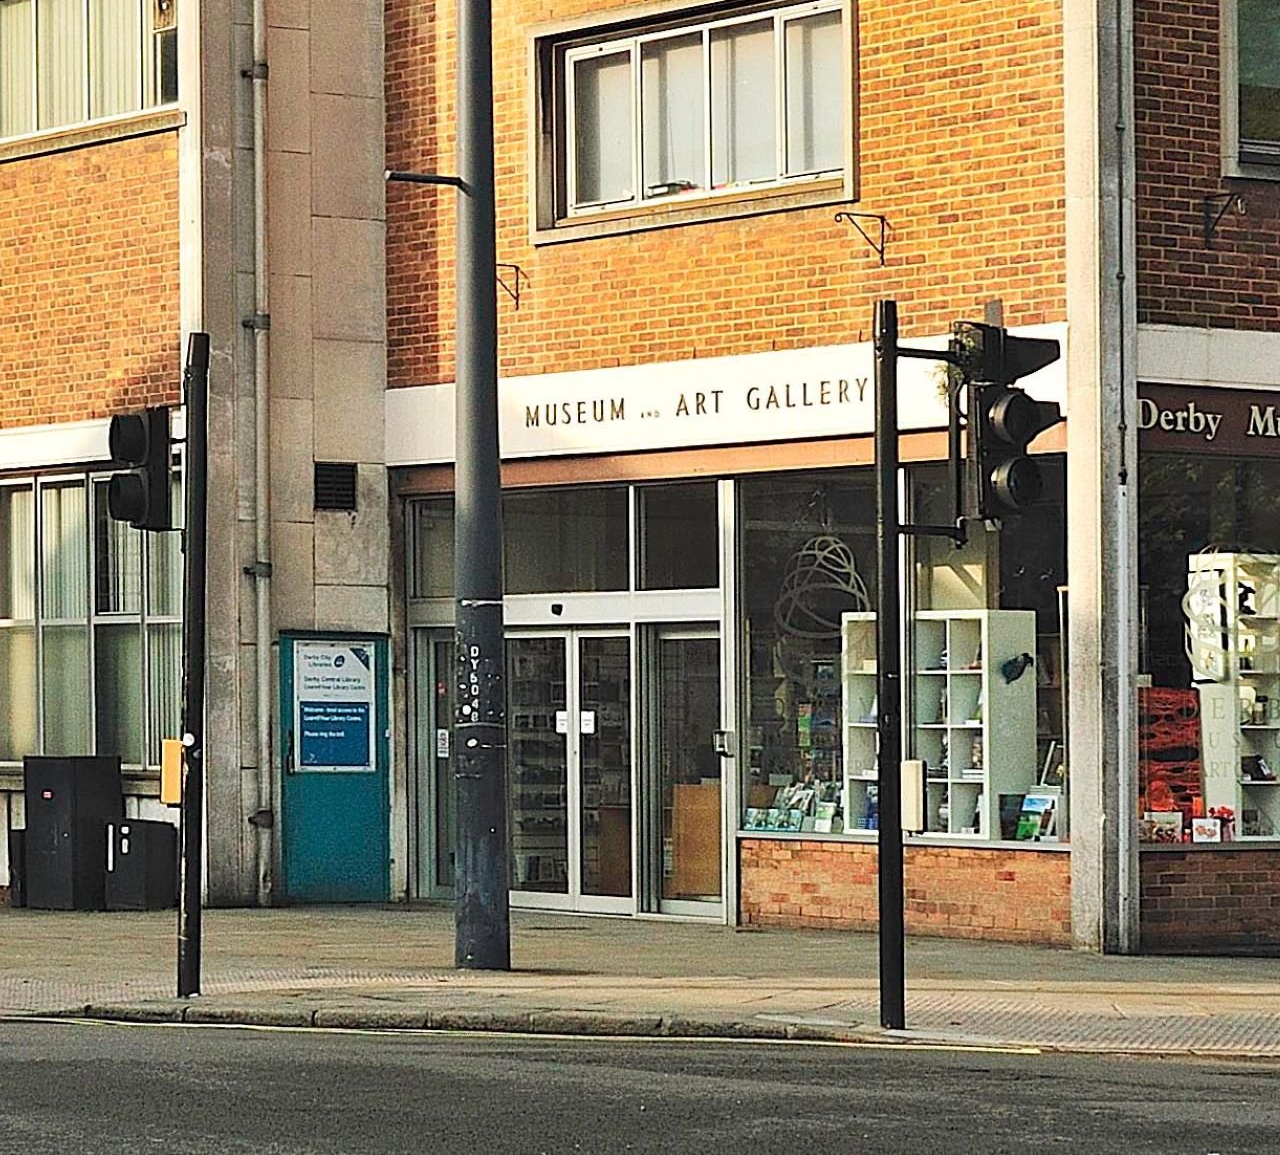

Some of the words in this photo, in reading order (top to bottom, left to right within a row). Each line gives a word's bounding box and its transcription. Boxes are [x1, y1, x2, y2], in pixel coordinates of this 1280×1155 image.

[525, 397, 626, 428] MUSEUM
[640, 409, 661, 419] AND
[675, 390, 724, 417] ART
[747, 377, 868, 411] GALLERY
[1137, 398, 1222, 441] Derby
[470, 646, 479, 722] DY6048
